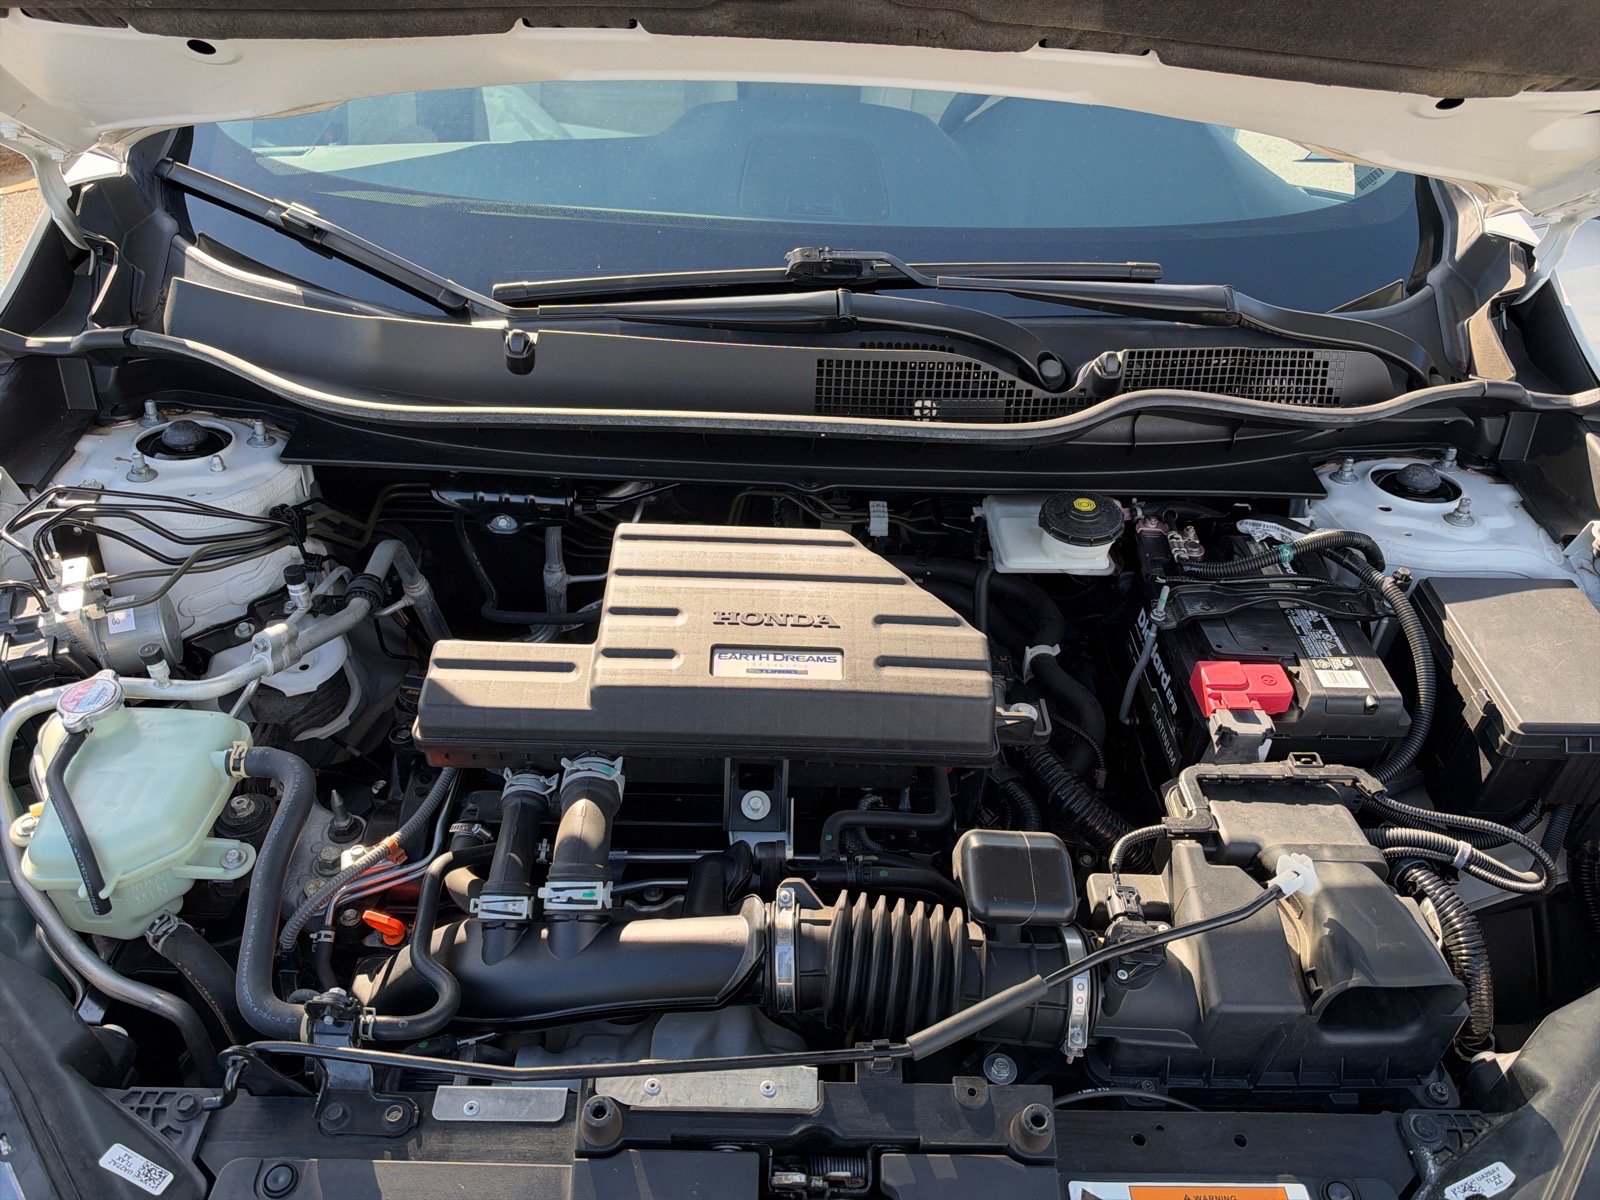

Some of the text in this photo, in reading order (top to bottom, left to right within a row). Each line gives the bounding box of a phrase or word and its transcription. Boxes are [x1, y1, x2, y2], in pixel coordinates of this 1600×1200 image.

[713, 611, 841, 629] HONDA
[717, 652, 837, 664] EARTH DREAMS
[1165, 689, 1179, 716] EFB
[1150, 703, 1177, 767] PLATINUM
[116, 1155, 133, 1168] TLAX
[1485, 1173, 1503, 1184] TLAX
